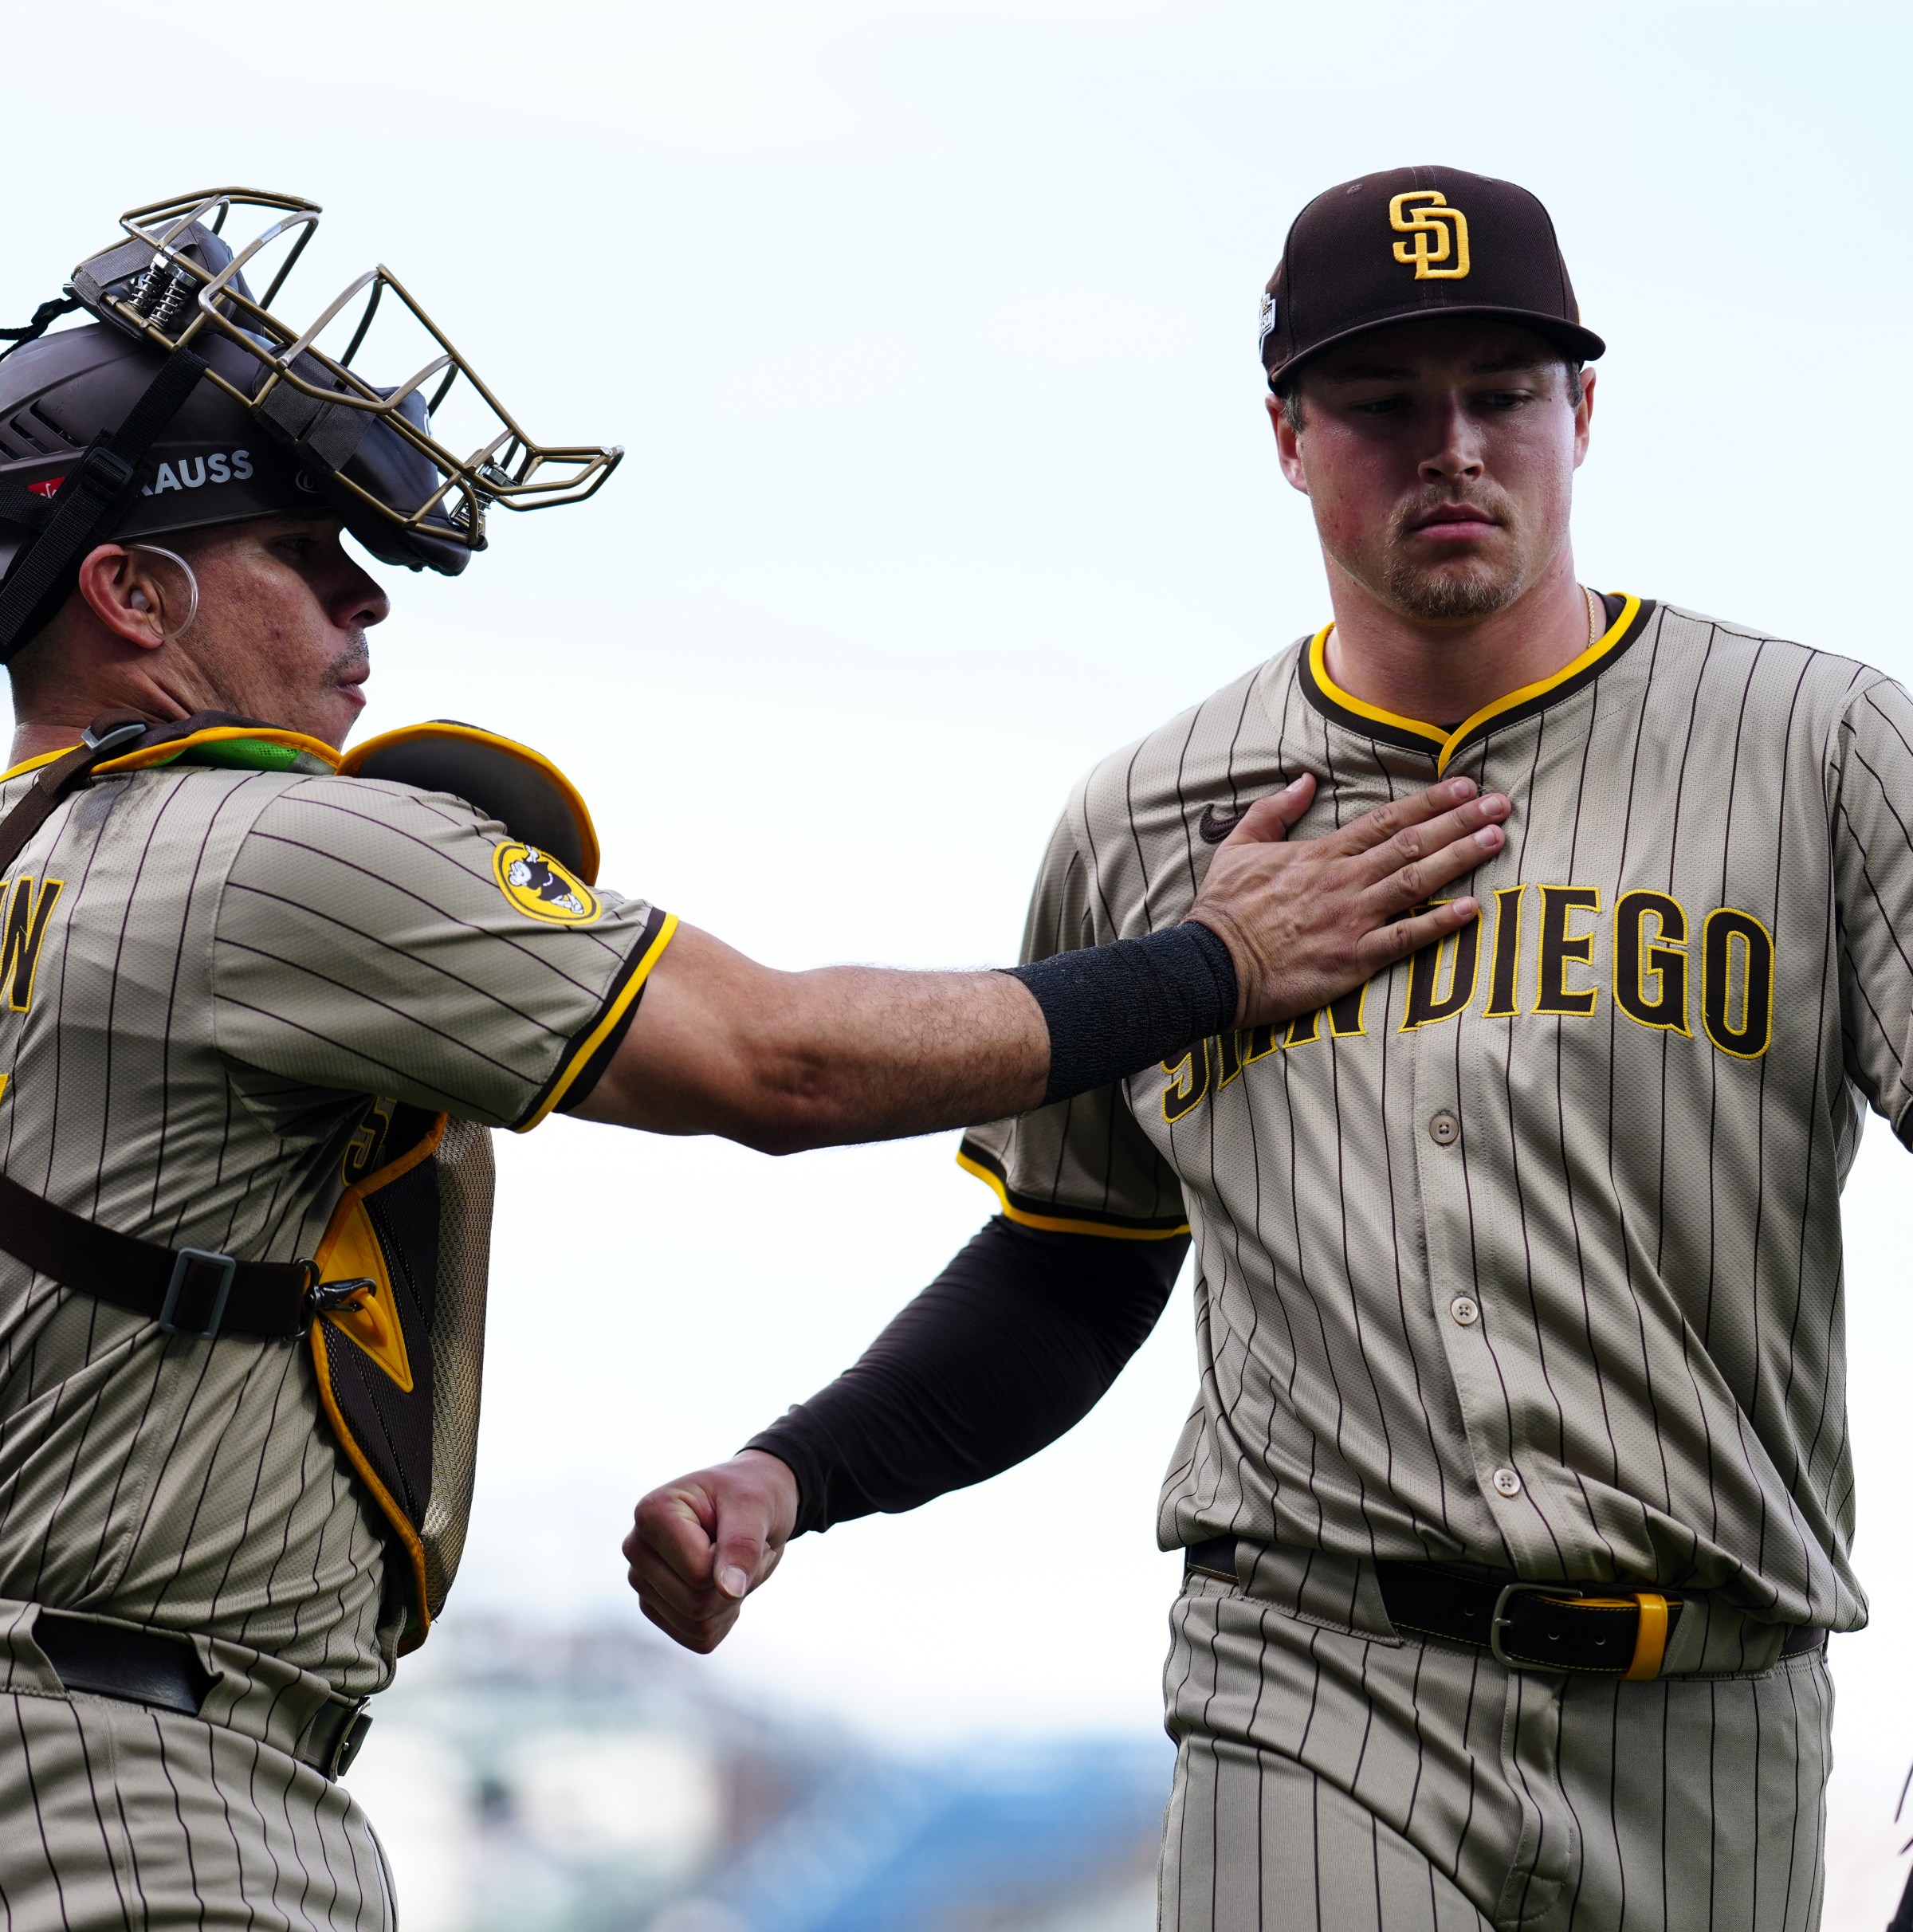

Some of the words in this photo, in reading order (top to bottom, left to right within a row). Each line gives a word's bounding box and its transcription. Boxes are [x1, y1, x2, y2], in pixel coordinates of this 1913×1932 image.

[1389, 190, 1470, 280] SD
[141, 450, 253, 497] AUSS
[1398, 883, 1775, 1060] DIEGO
